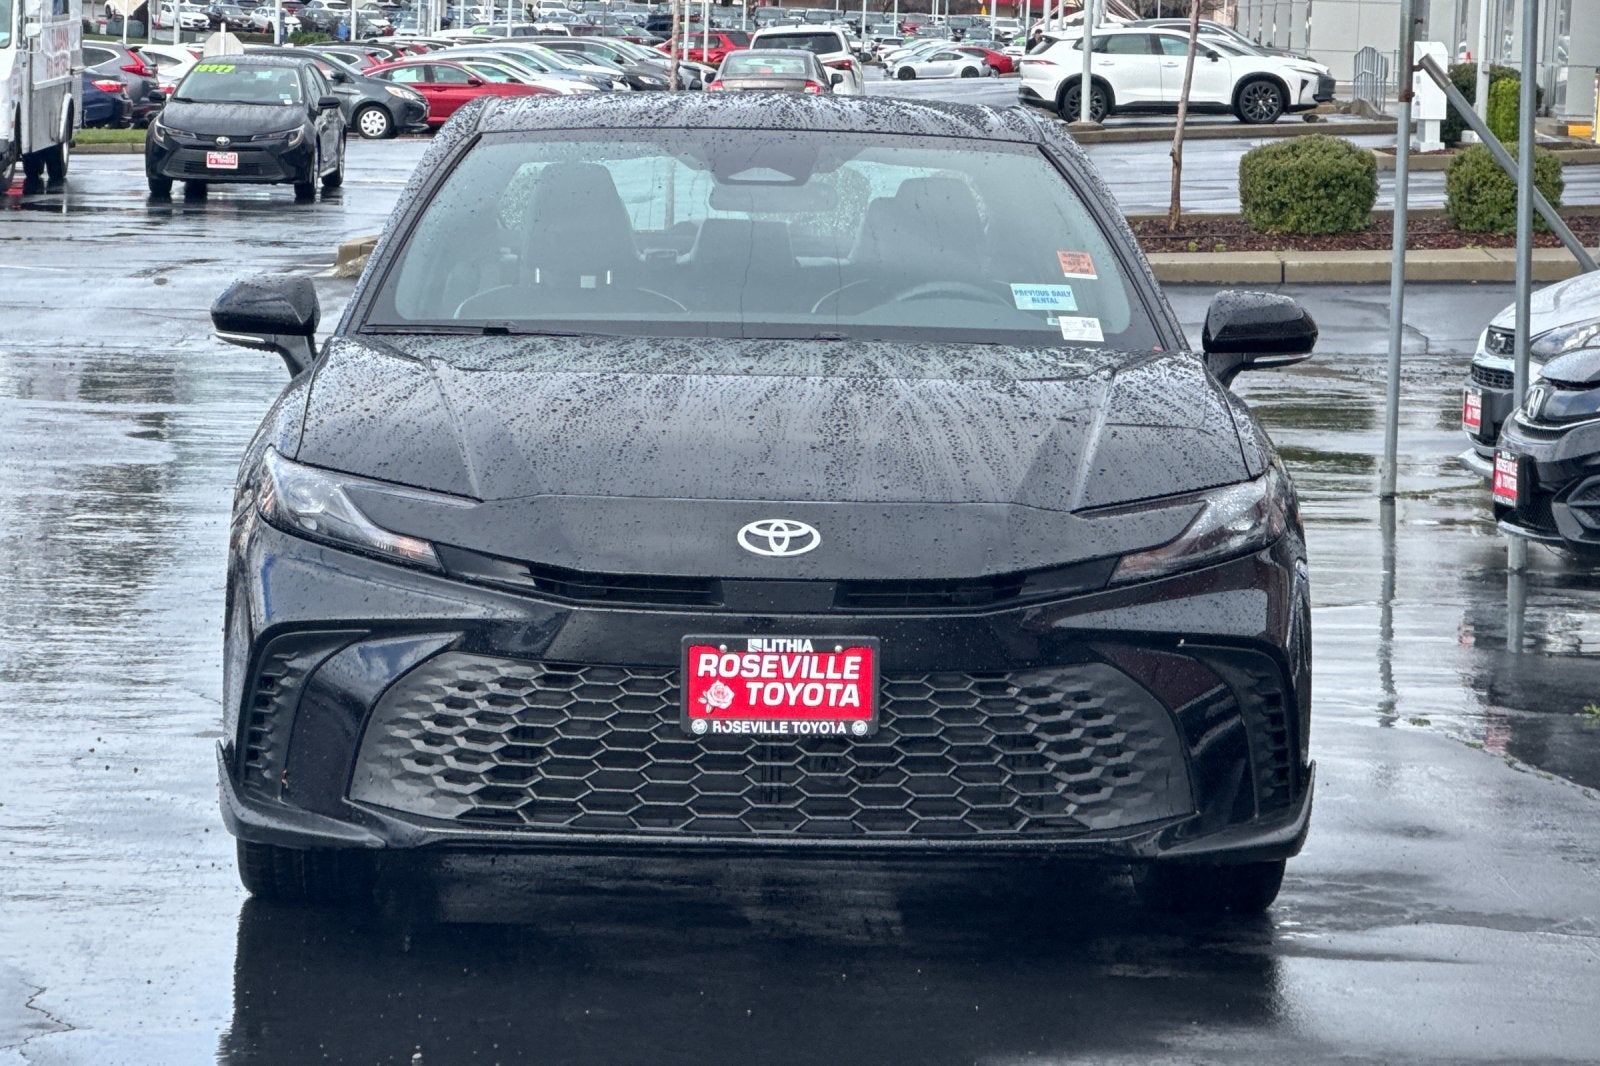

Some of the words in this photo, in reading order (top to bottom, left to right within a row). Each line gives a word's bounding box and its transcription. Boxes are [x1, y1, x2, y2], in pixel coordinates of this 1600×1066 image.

[1014, 289, 1050, 297] PREVIOUS
[1051, 290, 1071, 298] DAILY
[763, 639, 814, 653] LITHIA
[698, 653, 862, 680] ROSEVILLE
[746, 681, 860, 708] TOYOTA
[712, 720, 789, 734] ROSEVILLE
[791, 721, 847, 735] TOYOTA
